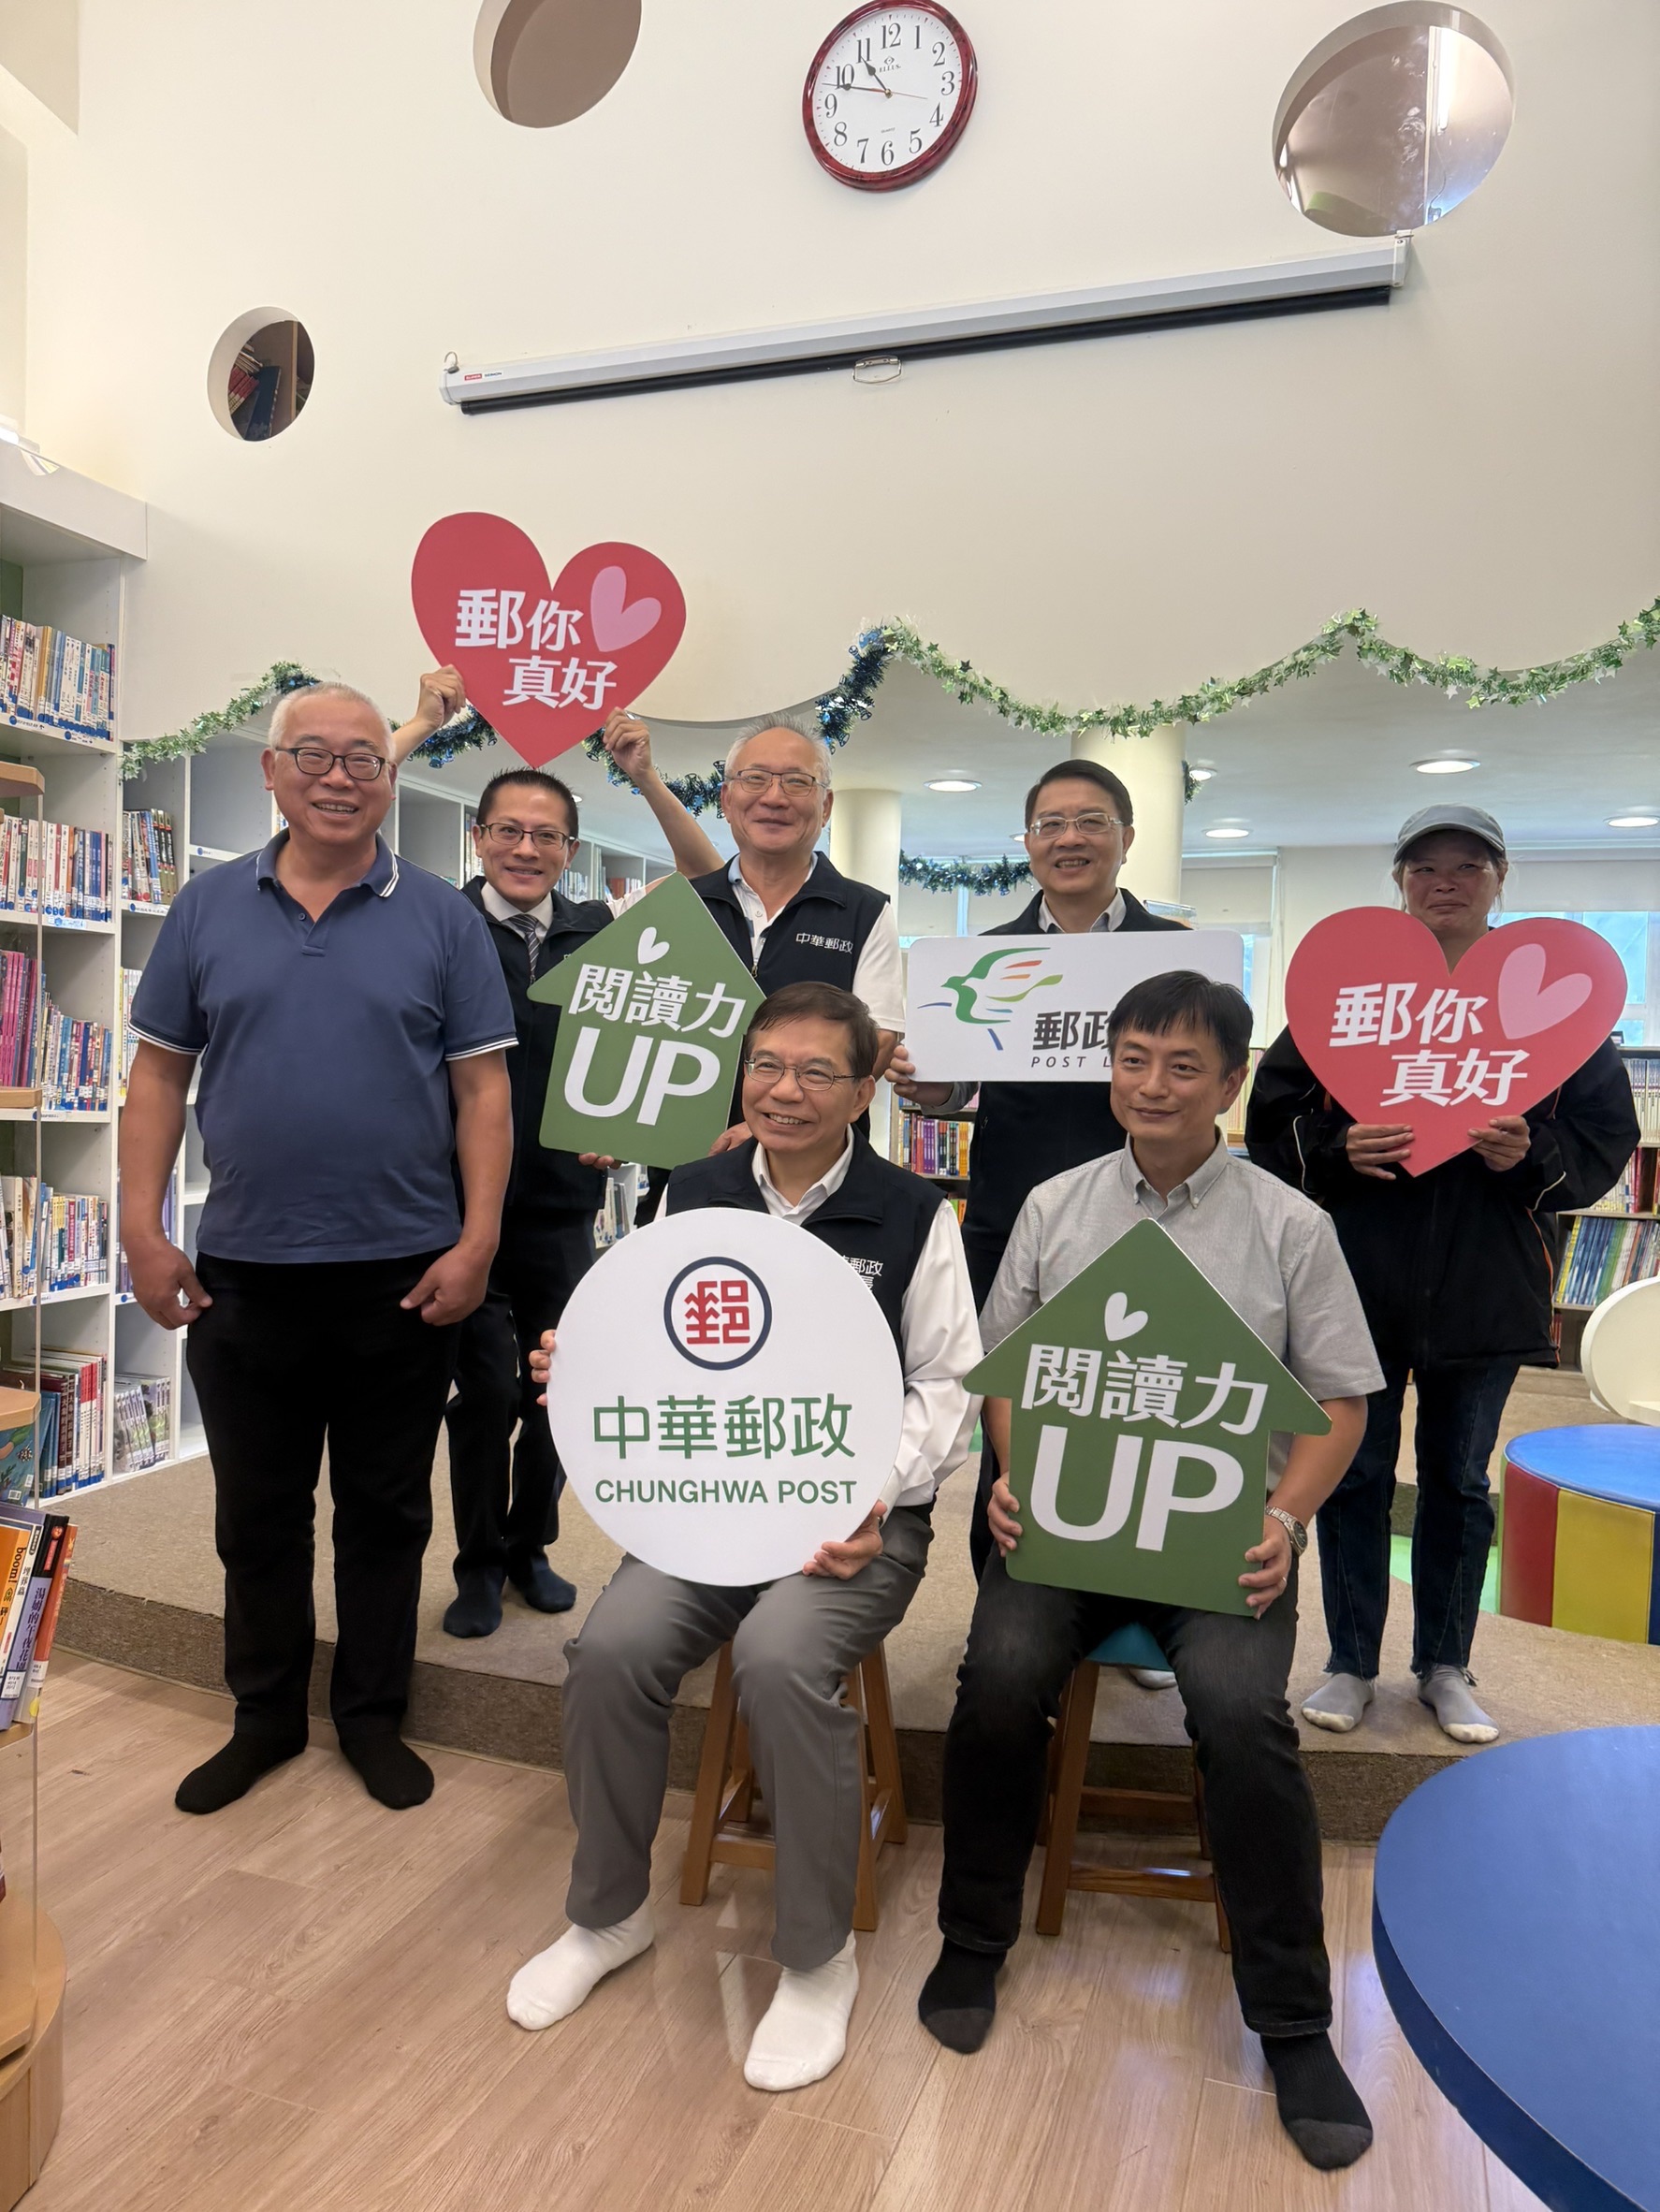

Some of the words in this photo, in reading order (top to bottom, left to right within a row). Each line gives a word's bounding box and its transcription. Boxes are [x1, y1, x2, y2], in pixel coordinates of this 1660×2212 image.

[880, 22, 901, 50] 12
[914, 25, 922, 50] 1
[856, 37, 871, 64] 11
[932, 41, 946, 66] 2
[836, 64, 855, 90] 10
[940, 71, 955, 95] 3
[824, 94, 837, 119] 9
[929, 102, 944, 127] 4
[834, 122, 848, 147] 8
[909, 128, 923, 153] 5
[856, 138, 869, 164] 7
[881, 140, 895, 166] 6
[455, 588, 584, 652] 郵你
[502, 655, 619, 710] 真好
[795, 932, 854, 954] 中華郵政
[568, 963, 747, 1039] 閱讀力
[1329, 982, 1489, 1047] 郵你
[1030, 1055, 1087, 1069] POST
[563, 1026, 721, 1127] UP
[1379, 1048, 1531, 1108] 真好
[843, 1255, 884, 1277] 郵政
[1021, 1343, 1269, 1435] 閱讀力
[593, 1392, 856, 1460] 中華郵政
[594, 1478, 769, 1505] CHUNGHWA
[778, 1479, 858, 1506] POST
[1029, 1423, 1245, 1552] UP
[8, 1547, 27, 1584] boom!
